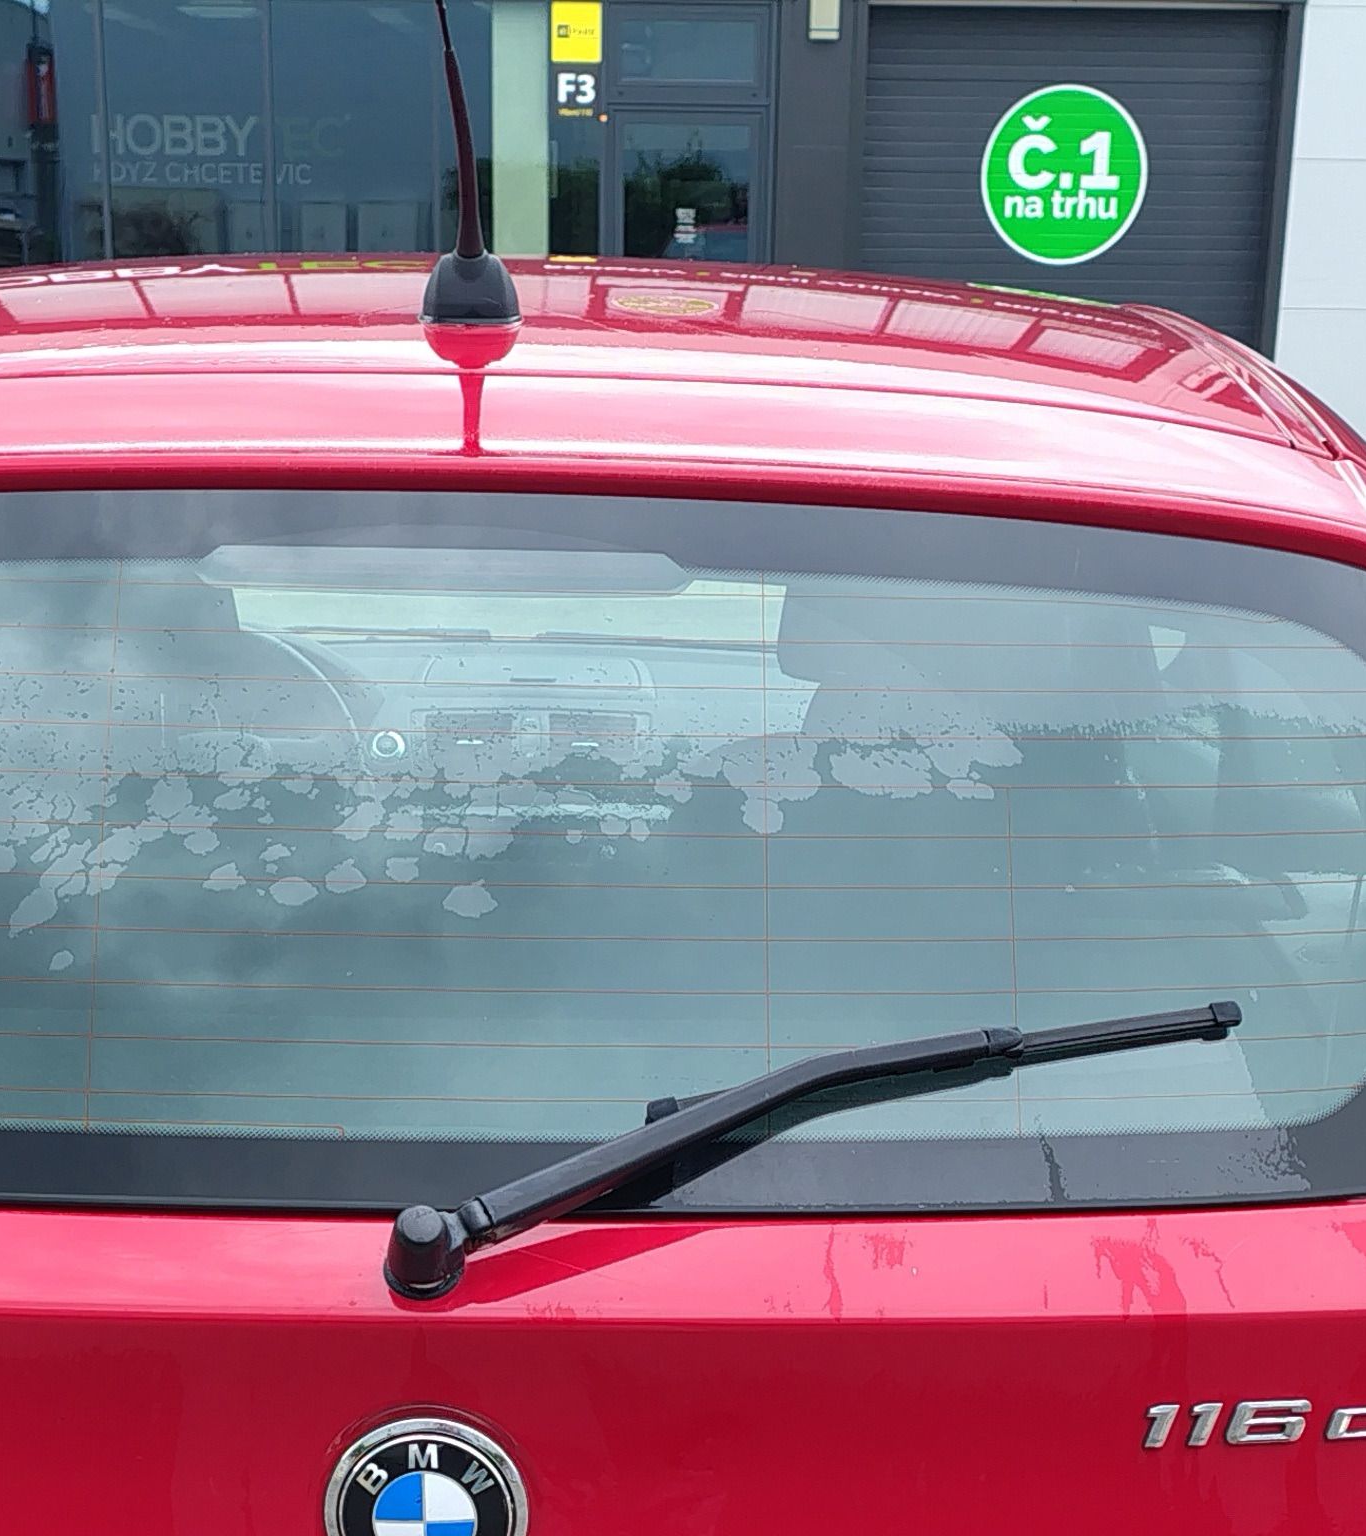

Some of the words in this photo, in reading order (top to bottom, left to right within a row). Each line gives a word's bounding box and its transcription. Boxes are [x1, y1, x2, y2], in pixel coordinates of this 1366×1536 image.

[557, 73, 596, 103] F3
[1008, 115, 1120, 190] Č.1
[1004, 195, 1045, 219] na
[1051, 189, 1119, 219] trhu
[355, 1443, 497, 1496] BMW
